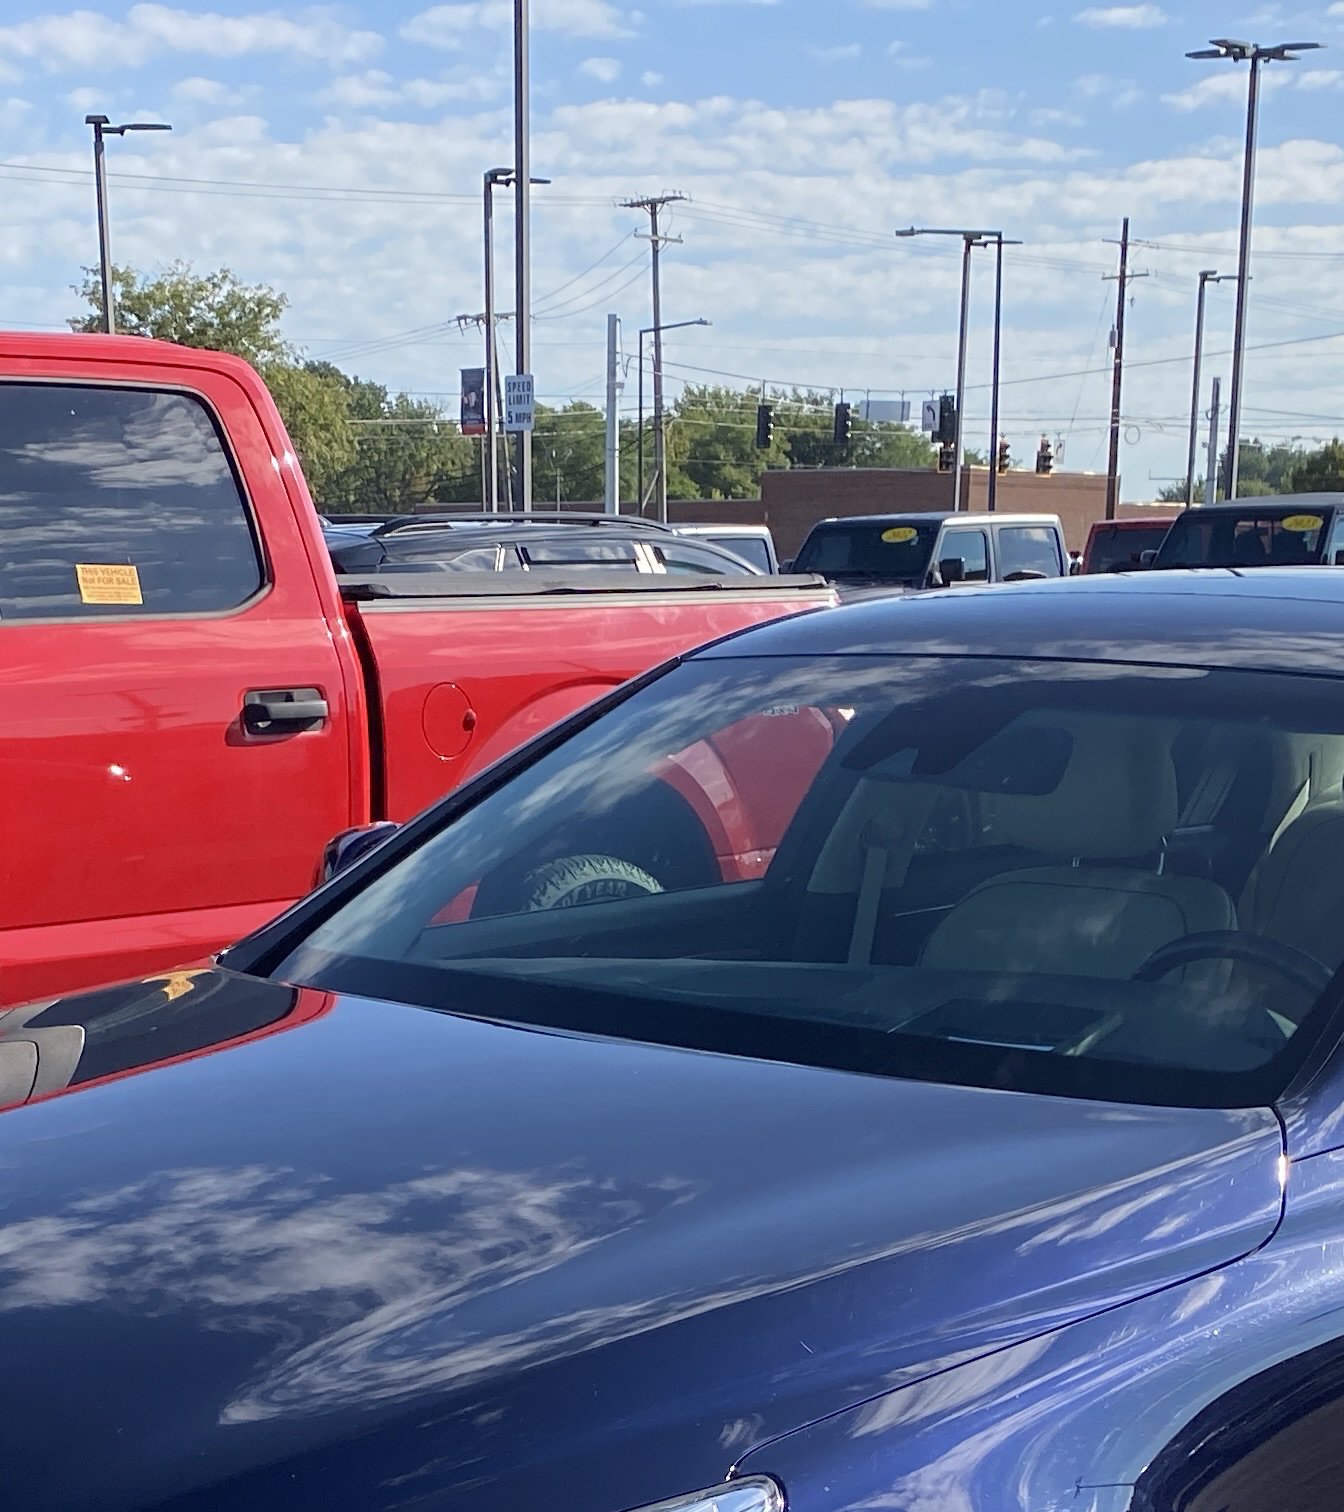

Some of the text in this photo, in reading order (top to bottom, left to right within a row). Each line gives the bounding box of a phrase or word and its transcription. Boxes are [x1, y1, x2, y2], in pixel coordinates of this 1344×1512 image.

[508, 381, 531, 393] SPEED
[508, 394, 530, 406] LIMIT
[507, 411, 532, 424] 5 MPH
[100, 567, 136, 577] VEHICLE
[97, 576, 114, 585] FOR
[115, 576, 137, 586] SALE
